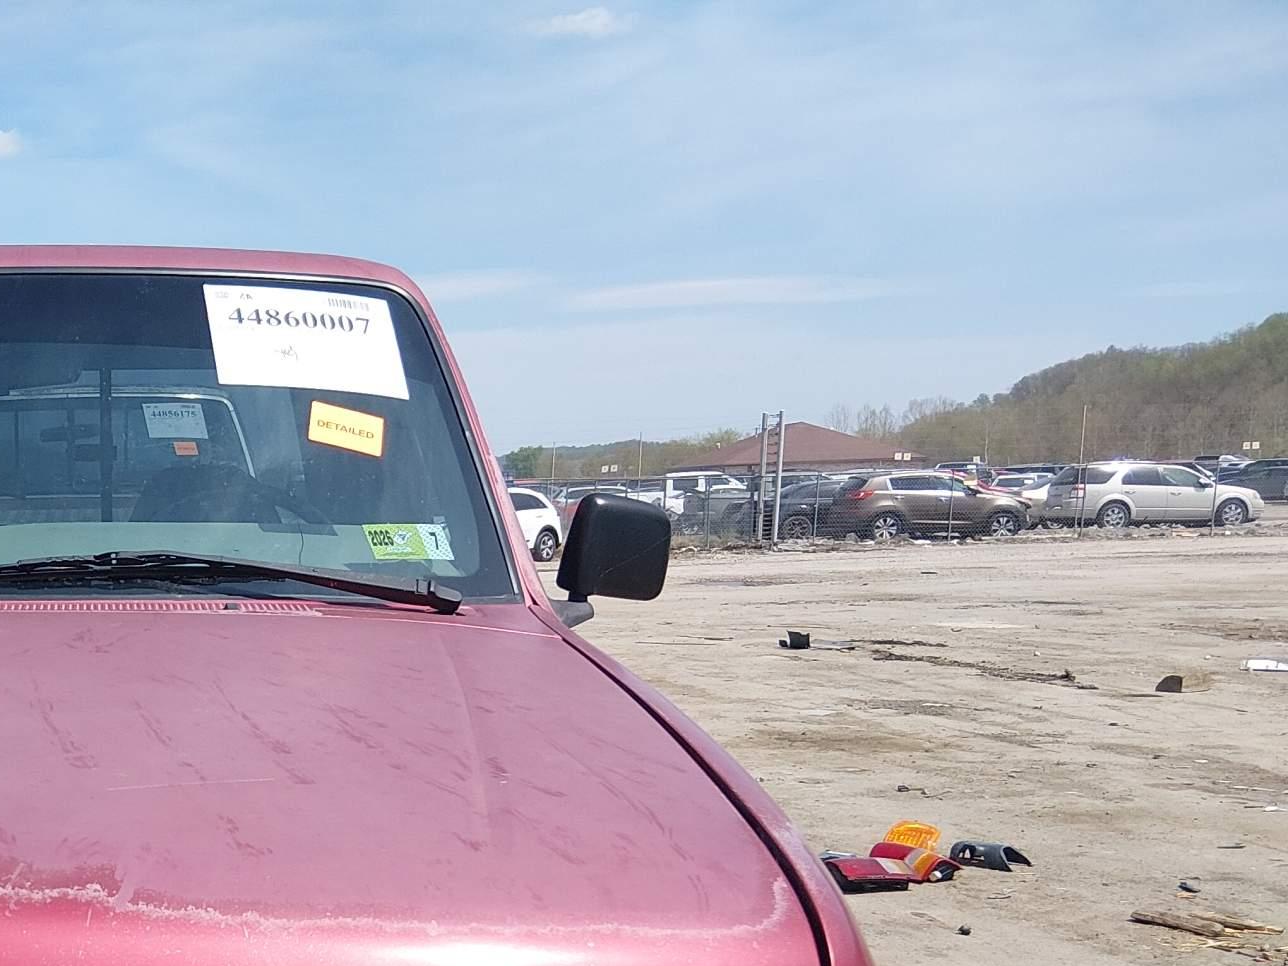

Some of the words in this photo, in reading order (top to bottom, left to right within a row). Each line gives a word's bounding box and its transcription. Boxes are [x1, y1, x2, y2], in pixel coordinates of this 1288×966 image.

[228, 306, 370, 335] 44860007
[316, 418, 375, 440] DETAILED
[428, 531, 439, 551] 7
